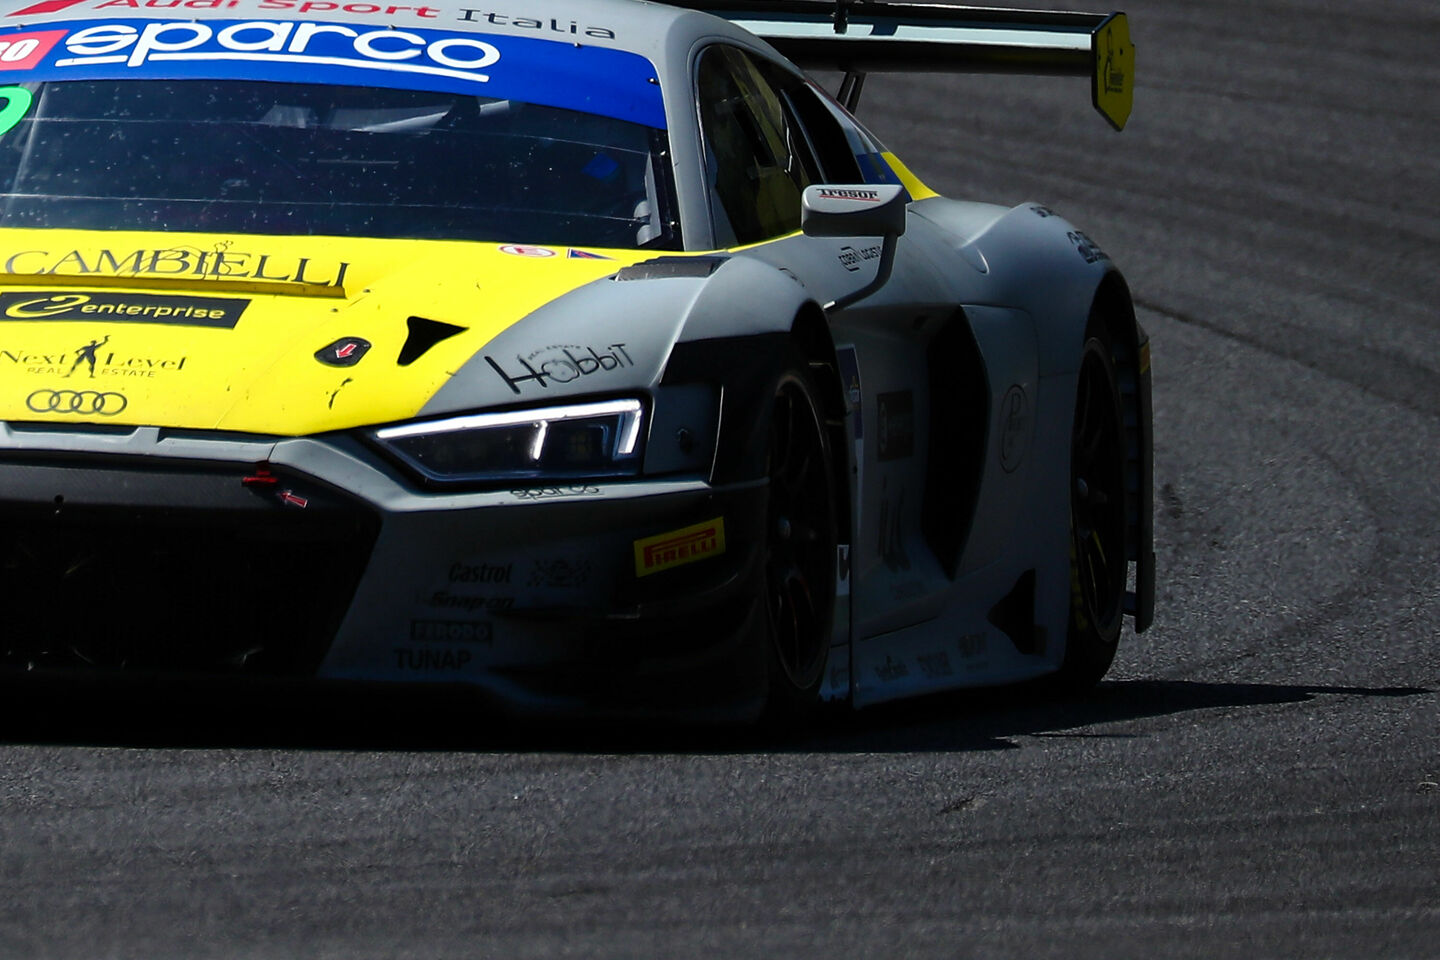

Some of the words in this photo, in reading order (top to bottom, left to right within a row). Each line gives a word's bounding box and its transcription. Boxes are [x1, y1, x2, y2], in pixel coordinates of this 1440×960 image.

[456, 7, 616, 39] Italia
[57, 21, 501, 72] sparco
[4, 248, 351, 288] CAMBIELLI
[81, 301, 225, 320] enterprise
[101, 368, 156, 378] ESTATE
[104, 352, 188, 371] Level
[643, 527, 717, 568] PIRELLI
[447, 560, 513, 585] Castrol
[392, 647, 474, 672] TUNAP
